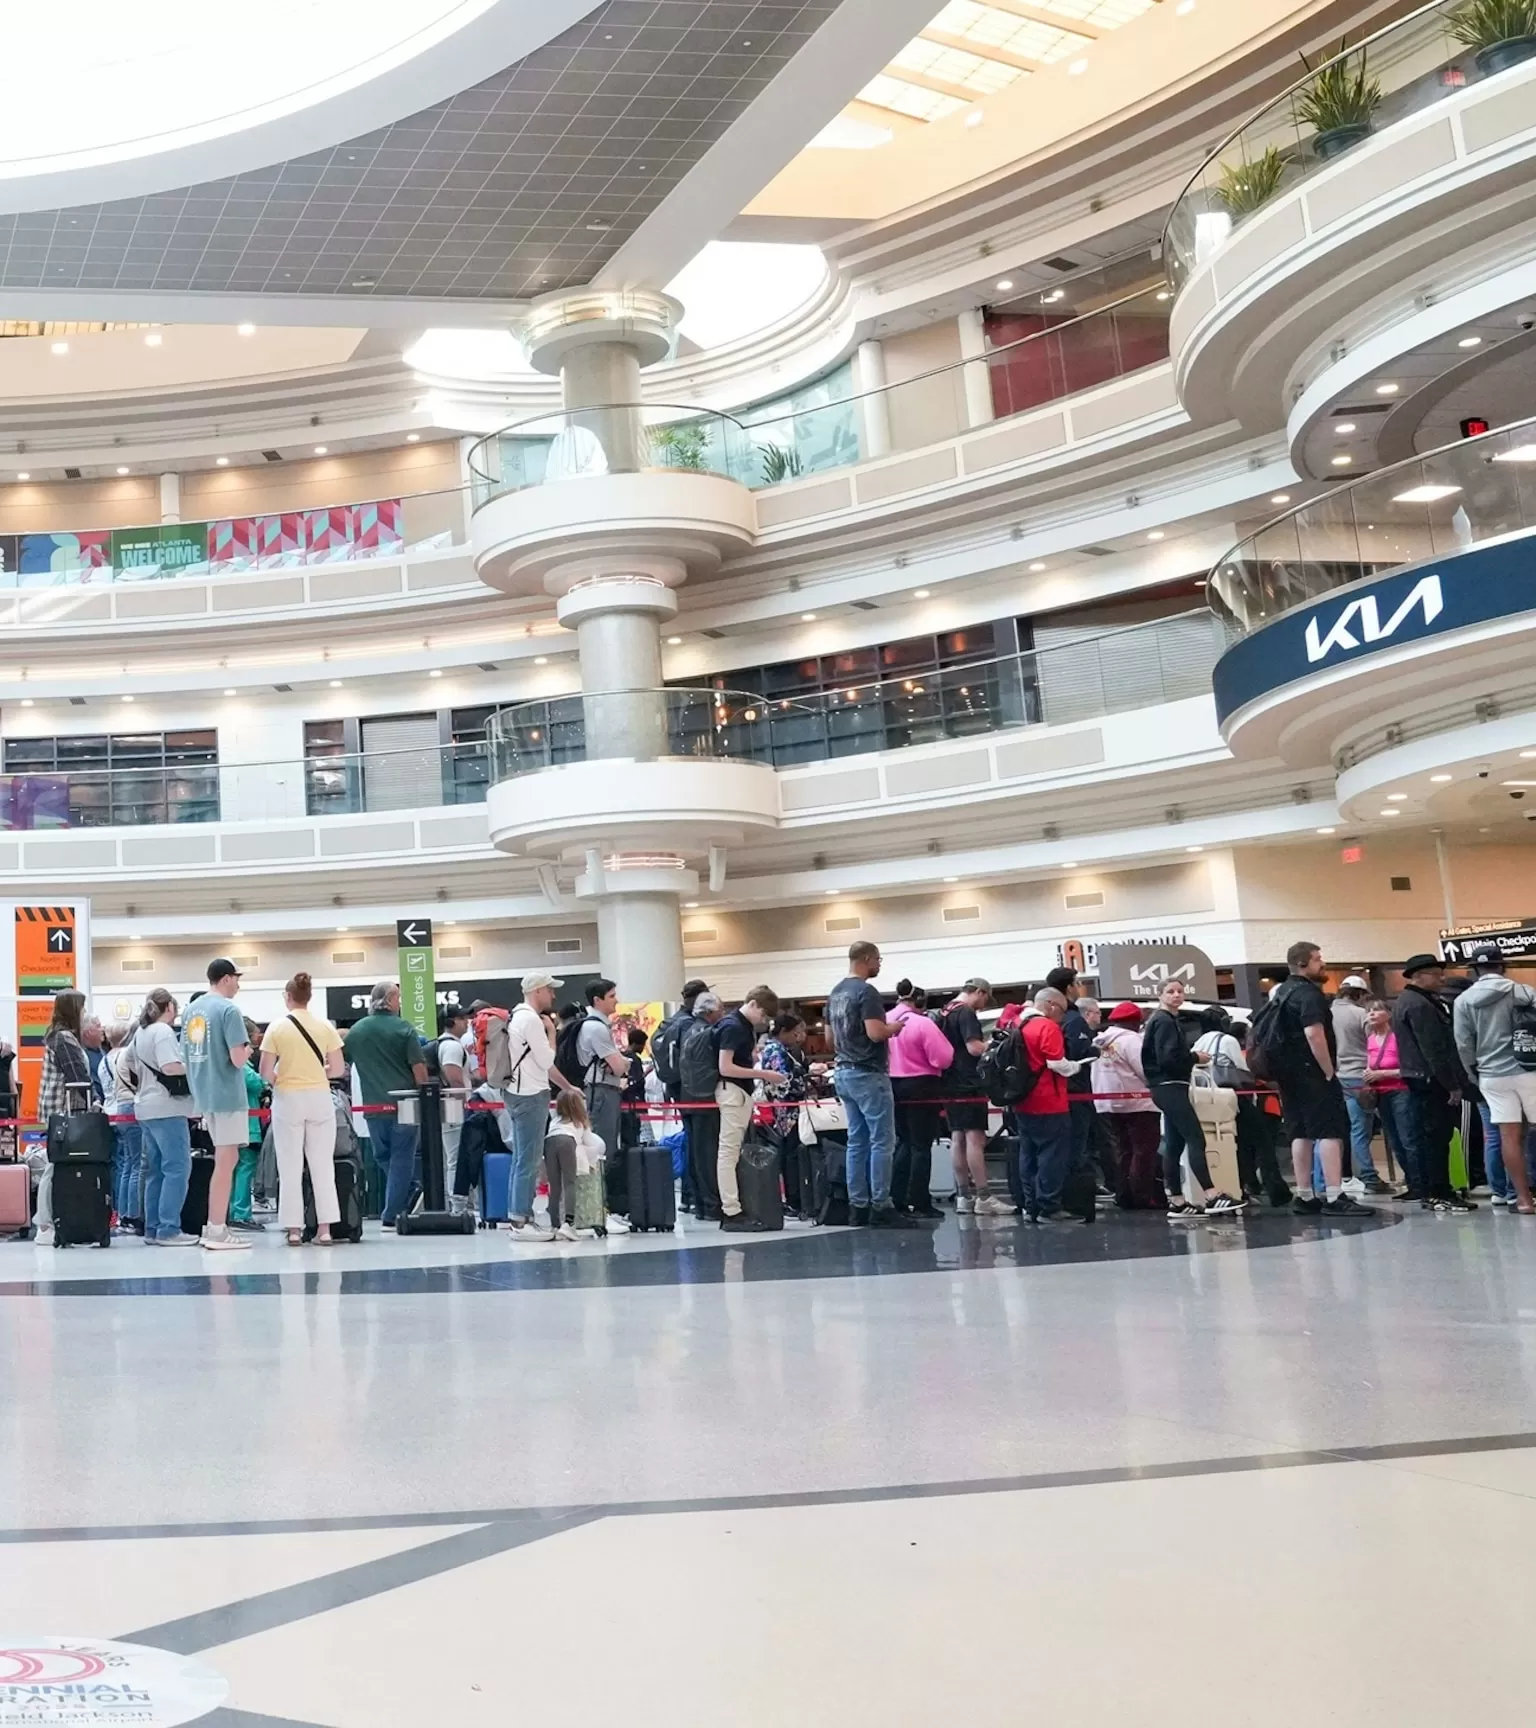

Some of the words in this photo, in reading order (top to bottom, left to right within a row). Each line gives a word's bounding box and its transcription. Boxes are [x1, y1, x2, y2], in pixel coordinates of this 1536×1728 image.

[152, 538, 193, 548] ATLANTA
[120, 545, 202, 569] WELCOME
[1304, 574, 1444, 663] KIA
[1129, 962, 1196, 981] KIA
[413, 975, 425, 1013] Gates
[1132, 984, 1152, 996] The
[413, 1016, 426, 1033] All
